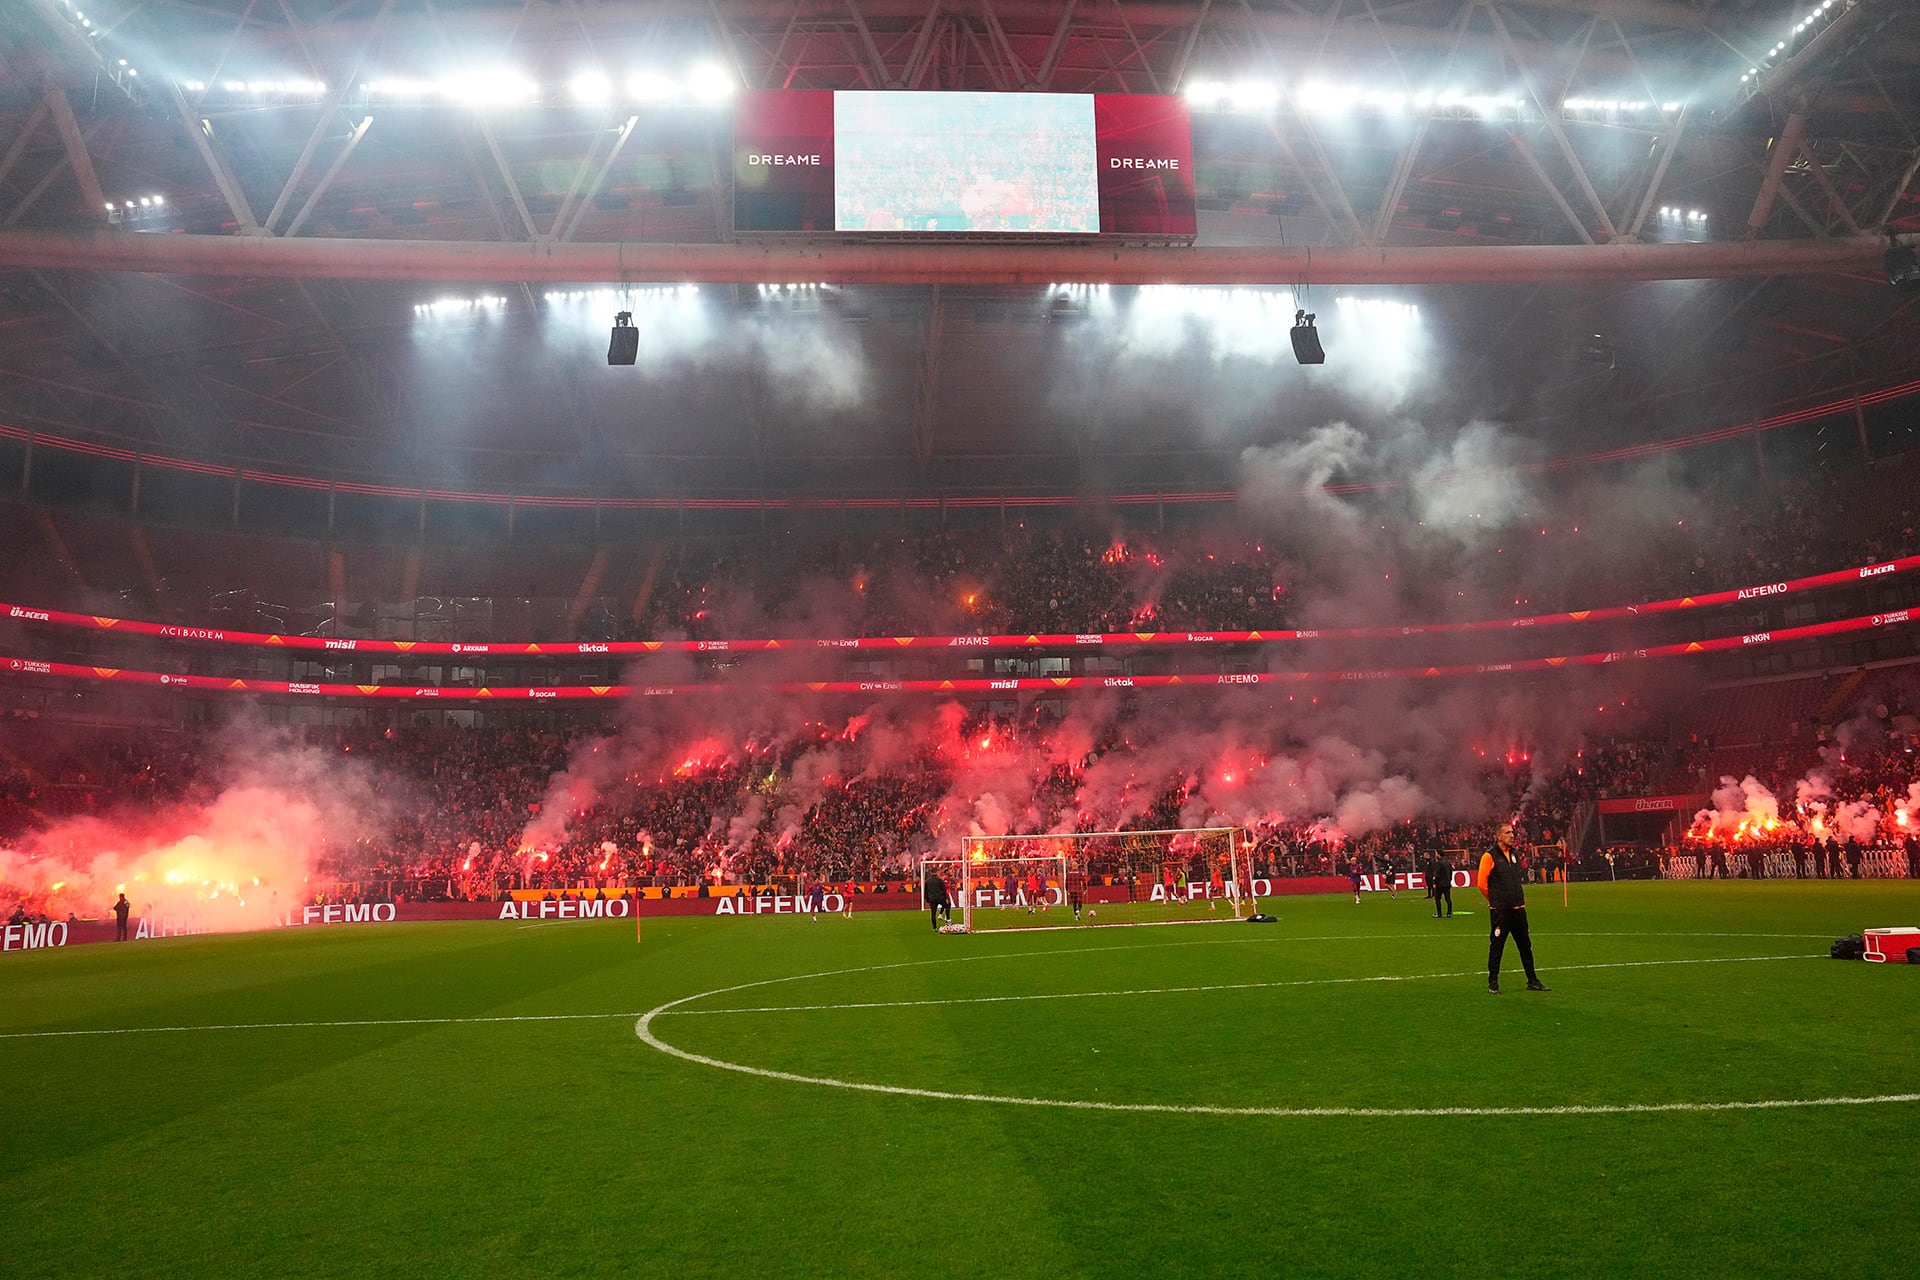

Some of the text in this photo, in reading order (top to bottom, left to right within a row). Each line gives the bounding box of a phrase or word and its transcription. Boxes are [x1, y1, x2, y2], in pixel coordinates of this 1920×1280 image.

[749, 155, 820, 166] DREAME
[1110, 157, 1179, 170] DREAME
[1859, 564, 1895, 578] ÜLKER
[1738, 583, 1788, 600] ALFEMO
[10, 606, 49, 621] ÜLKER
[1883, 611, 1908, 619] TURKISH
[1884, 616, 1909, 625] AIRLINES
[160, 627, 224, 640] ACIBADEM
[1751, 633, 1770, 643] NGN
[325, 640, 357, 650] misli
[958, 637, 989, 646] RAMS
[578, 643, 609, 653] tiktak
[23, 660, 50, 668] TURKISH
[990, 679, 1018, 689] misli
[1103, 678, 1134, 687] tiktak
[1218, 674, 1259, 684] ALFEMO
[860, 682, 874, 690] CW
[1635, 799, 1674, 811] ÜLKER
[1359, 871, 1470, 891] ALFEO
[499, 898, 628, 920] ALFEMO
